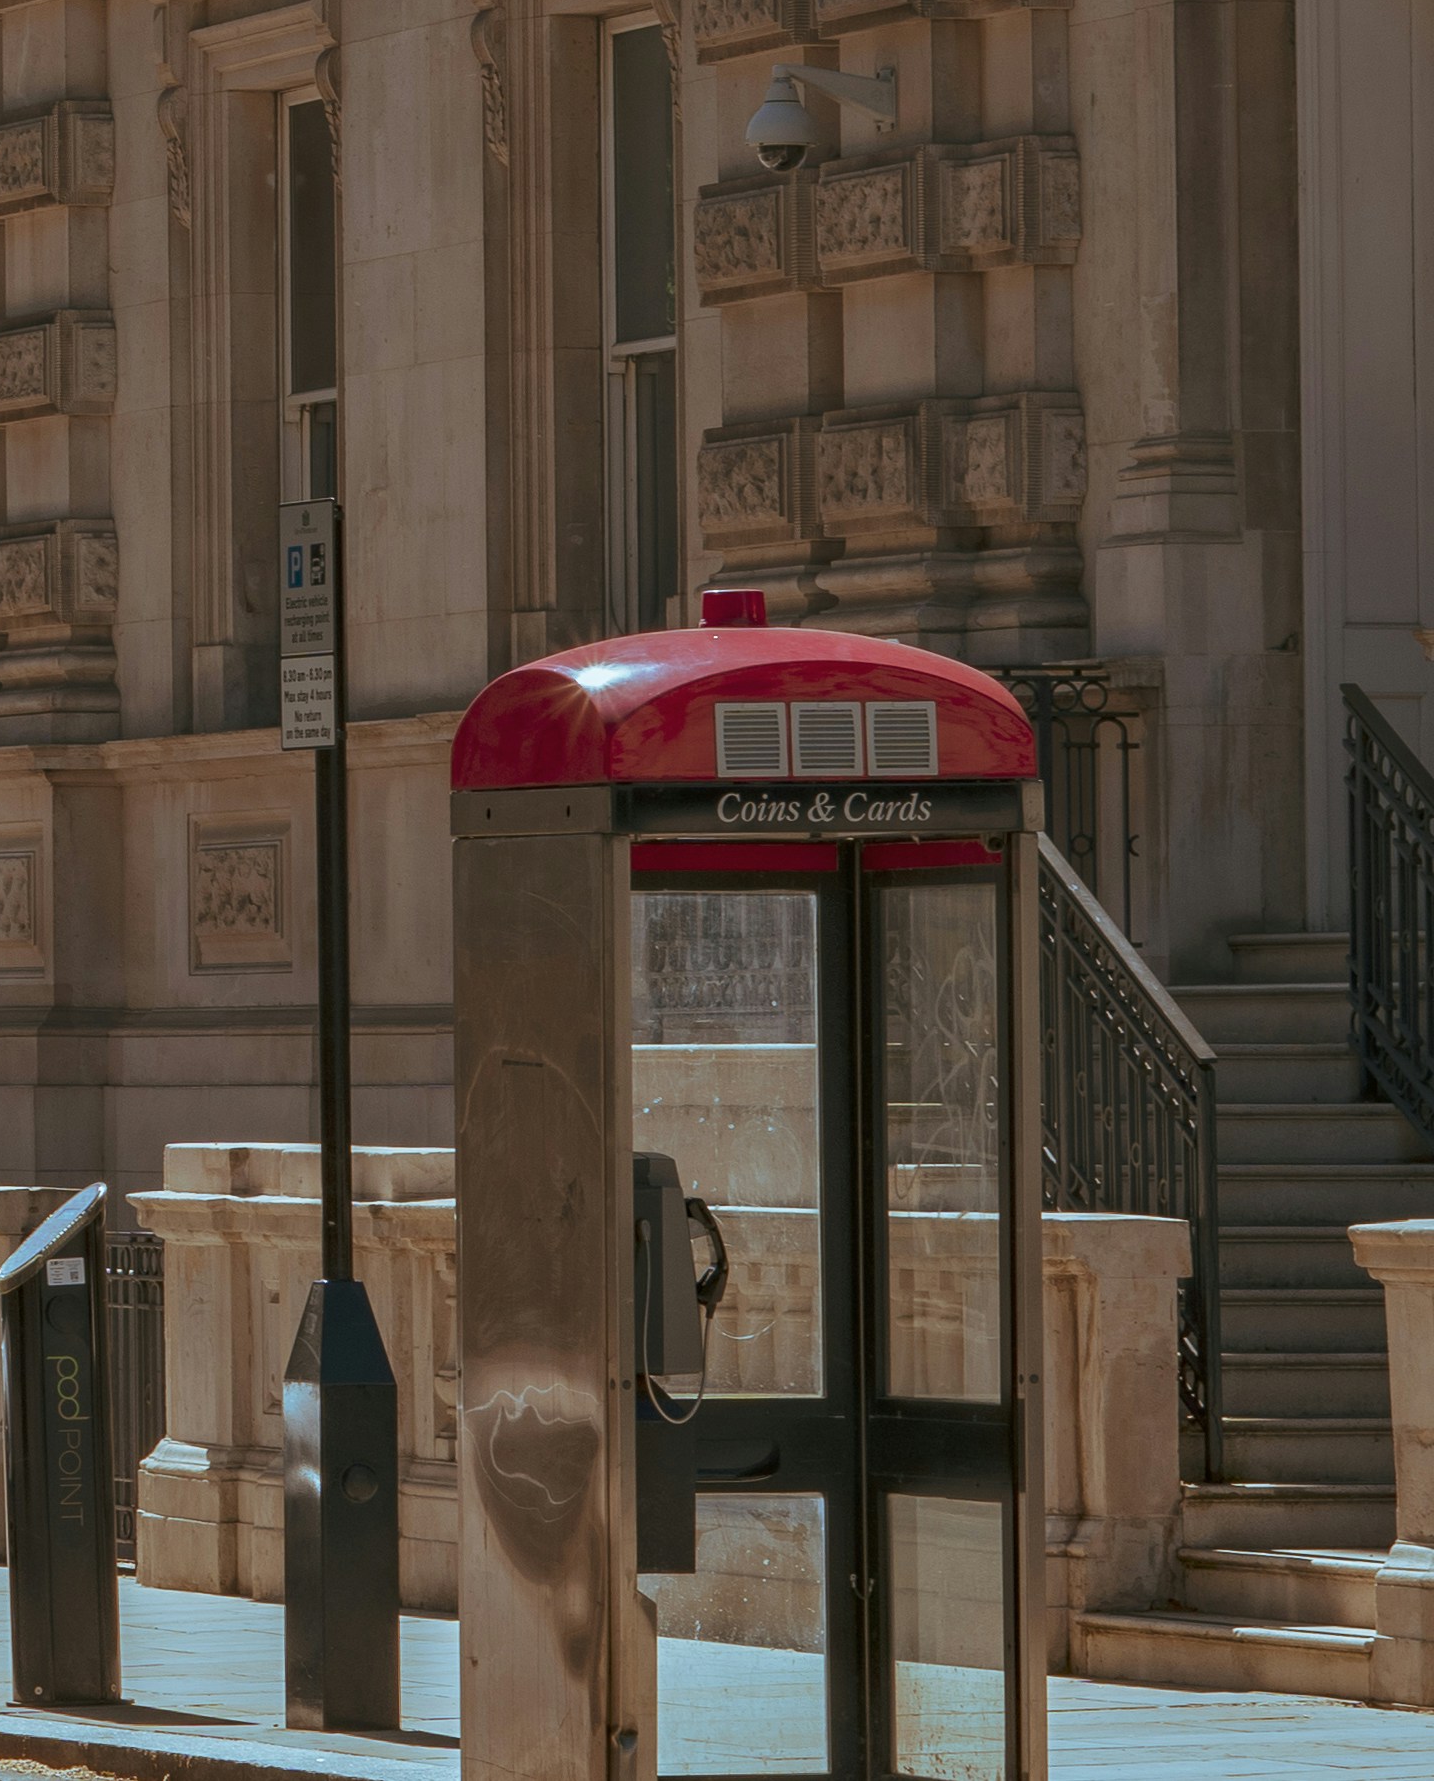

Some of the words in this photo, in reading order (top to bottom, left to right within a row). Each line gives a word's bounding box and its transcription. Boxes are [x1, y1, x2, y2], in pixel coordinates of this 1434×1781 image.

[286, 595, 307, 610] Electric
[309, 595, 328, 607] vehicle
[284, 614, 314, 628] recharging
[315, 612, 330, 626] point
[292, 632, 297, 643] at
[298, 631, 306, 643] all
[308, 629, 323, 642] times
[284, 690, 296, 703] Max
[298, 690, 308, 704] stay
[316, 689, 332, 701] hours
[295, 711, 302, 723] No
[304, 710, 321, 722] return
[286, 730, 293, 739] on
[294, 727, 303, 739] the
[305, 728, 319, 738] same
[320, 725, 330, 739] day
[716, 792, 801, 824] Coins
[807, 792, 836, 823] &
[844, 792, 932, 823] Cards
[46, 1355, 90, 1420] pod
[58, 1429, 84, 1526] POINT
